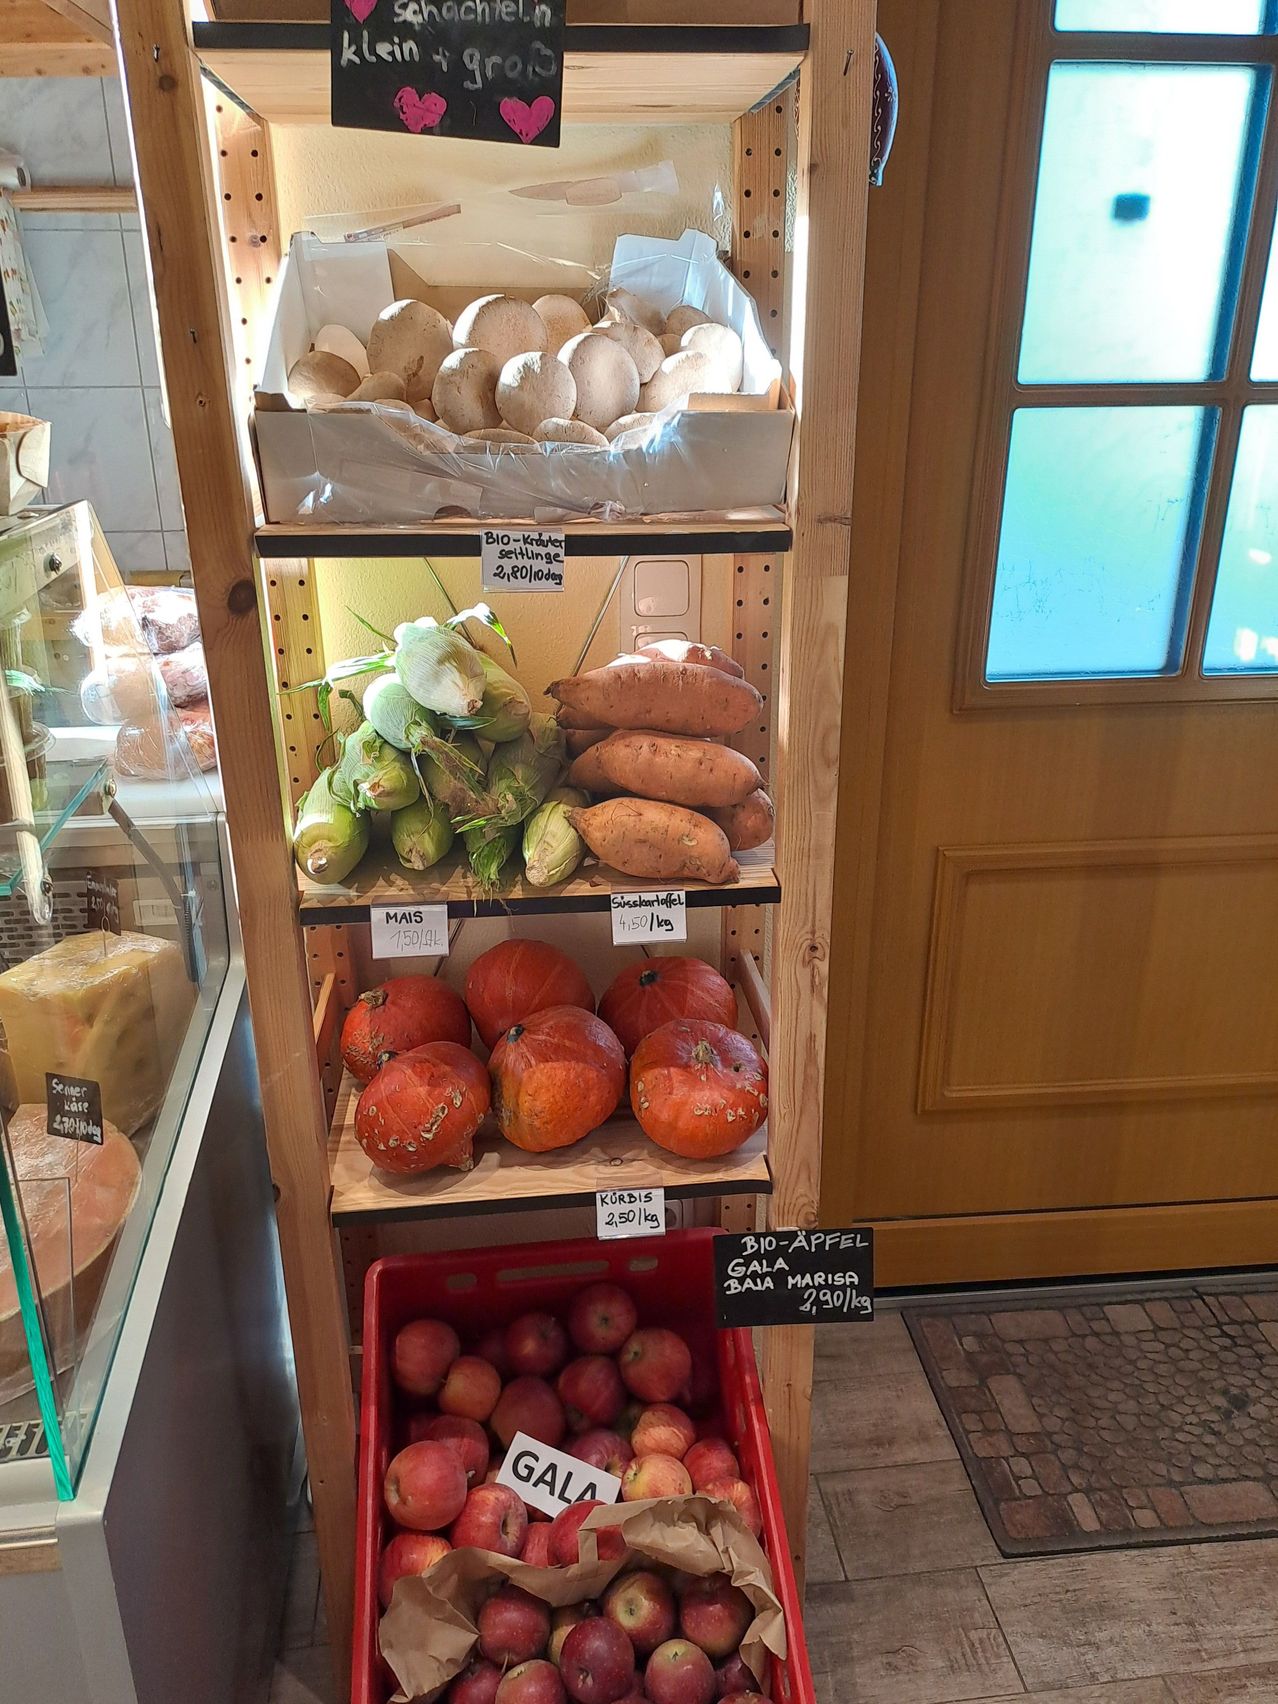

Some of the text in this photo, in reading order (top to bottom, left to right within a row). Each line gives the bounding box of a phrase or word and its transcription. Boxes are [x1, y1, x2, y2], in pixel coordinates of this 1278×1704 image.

[340, 29, 420, 67] klein
[484, 531, 564, 549] BIO-Kräuter
[497, 546, 564, 564] seitlinge
[492, 564, 563, 585] 2,80/10dag
[611, 893, 685, 909] Süsskartoffel
[385, 911, 424, 925] MAIS
[619, 912, 674, 932] 4,50/kg
[600, 1192, 653, 1207] KÜRBIS
[605, 1207, 661, 1229] 2,50/kg
[741, 1231, 869, 1256] BIO-ÄPFEL
[727, 1257, 790, 1278] GALA
[787, 1271, 859, 1290] MARISA
[799, 1287, 873, 1316] 2,90/kg
[511, 1450, 597, 1505] GALA
